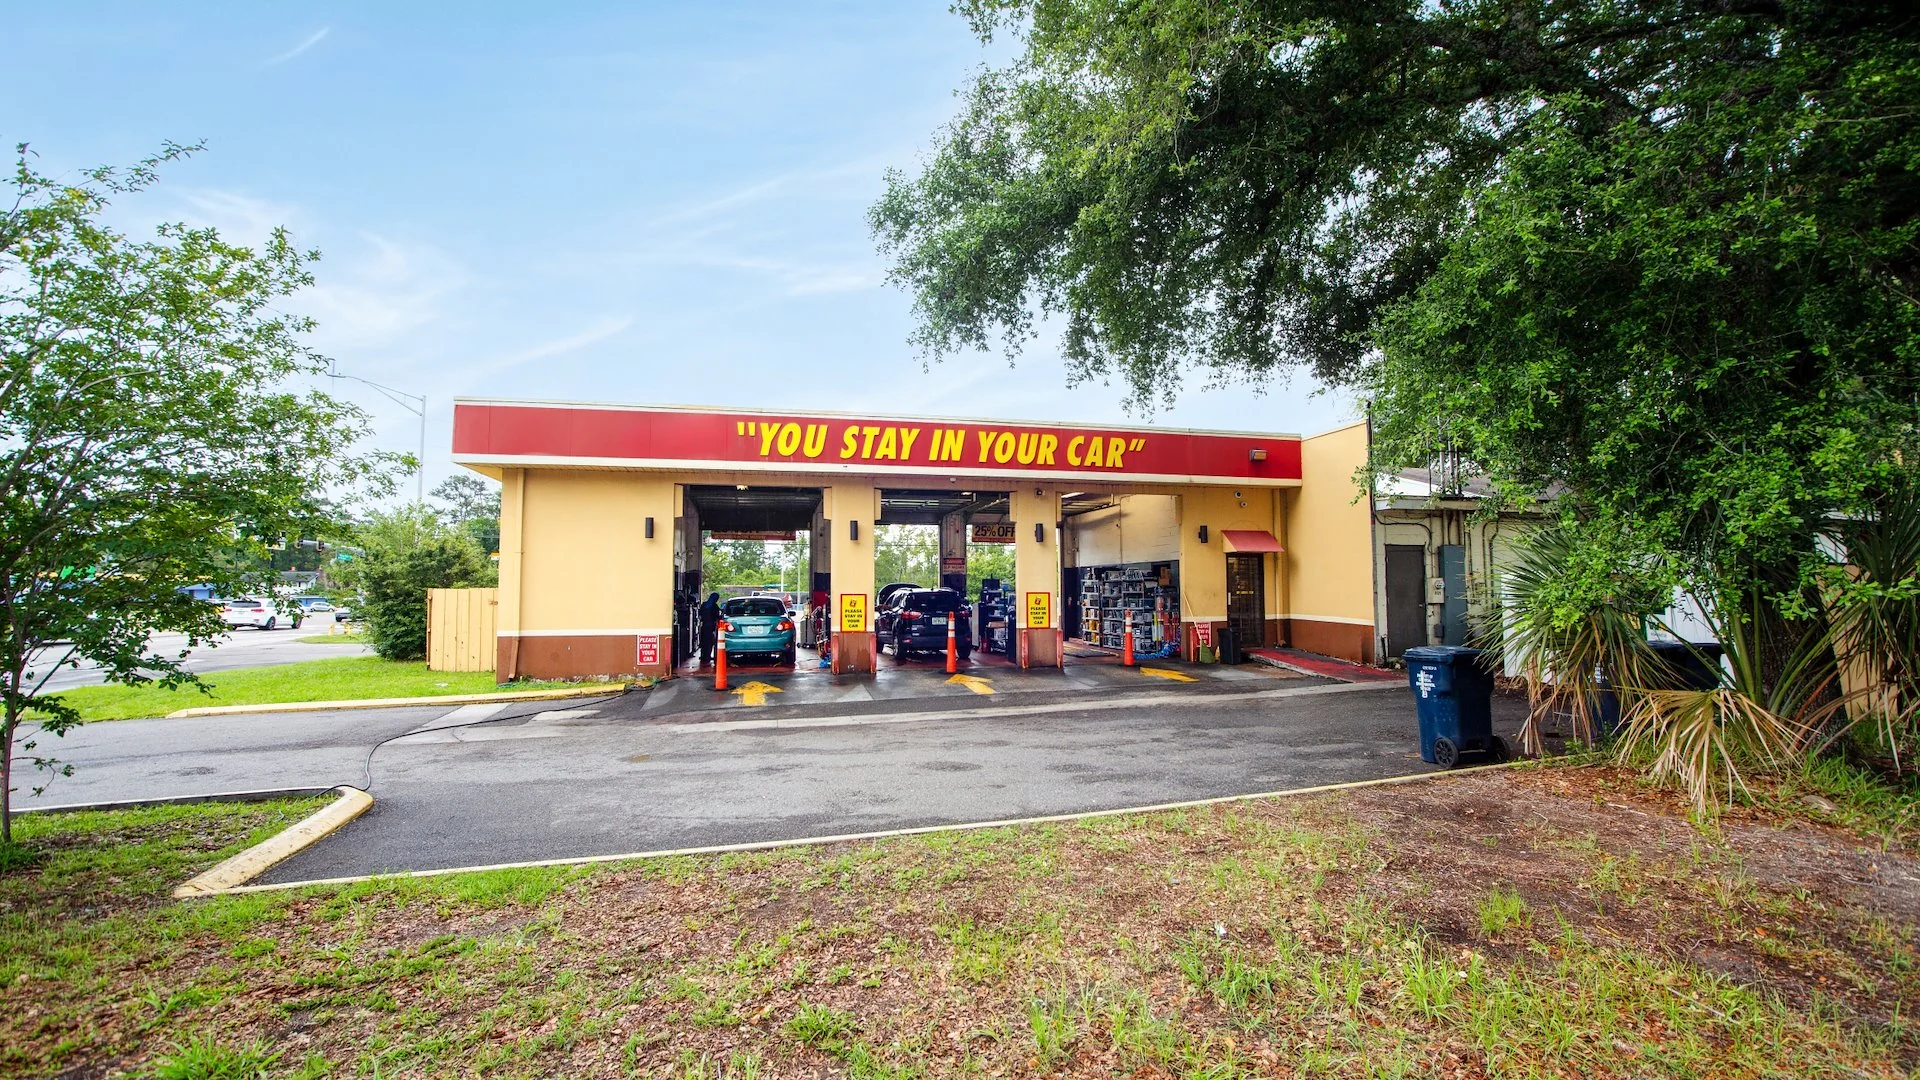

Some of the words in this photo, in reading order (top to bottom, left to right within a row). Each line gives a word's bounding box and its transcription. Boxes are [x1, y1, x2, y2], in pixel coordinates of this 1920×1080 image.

[839, 425, 920, 460] STAY
[928, 429, 966, 461] IN
[978, 431, 1059, 466] YOUR
[974, 525, 997, 537] 25%
[997, 526, 1016, 537] OFF
